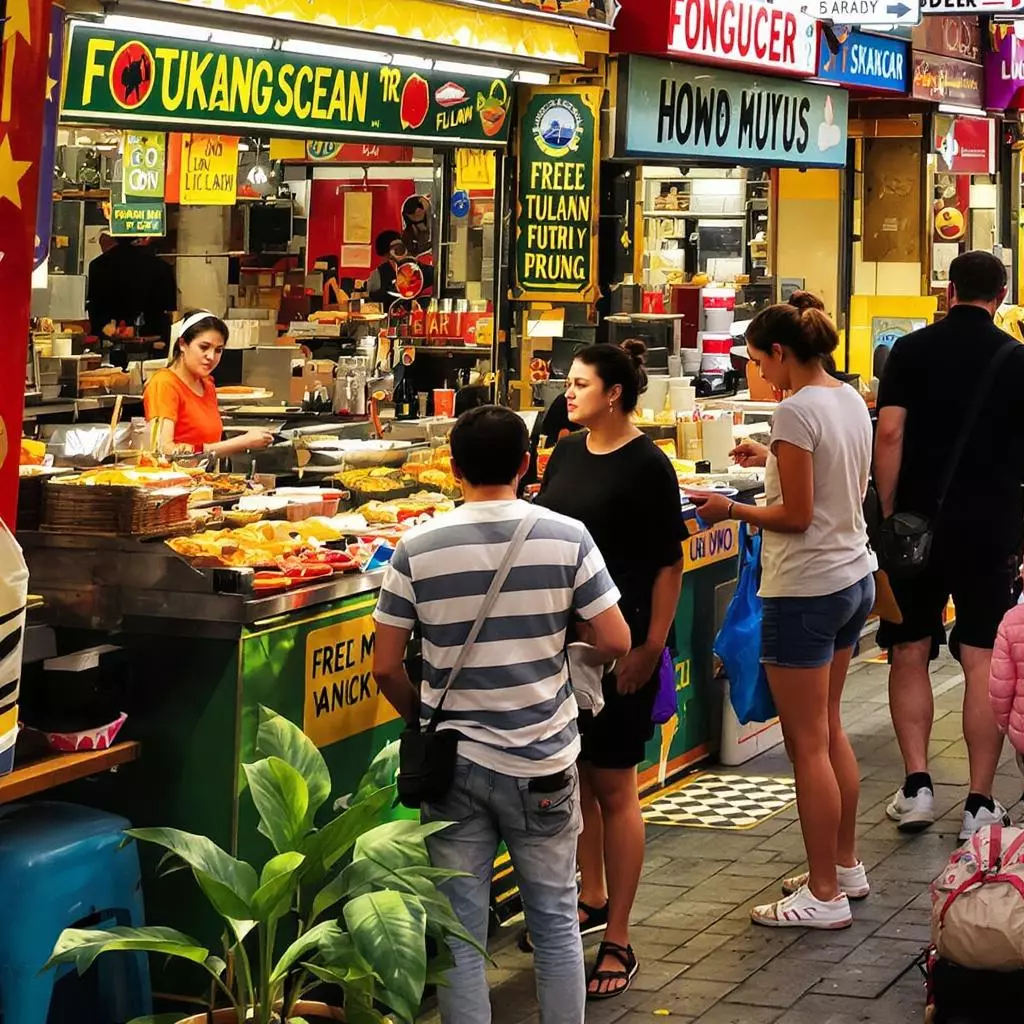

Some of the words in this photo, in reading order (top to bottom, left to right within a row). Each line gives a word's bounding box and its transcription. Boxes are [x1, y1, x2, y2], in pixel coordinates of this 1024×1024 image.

[657, 79, 732, 148] HOWO
[738, 88, 810, 154] MUYUS
[531, 160, 587, 191] FREEE
[524, 253, 587, 282] PRUNG
